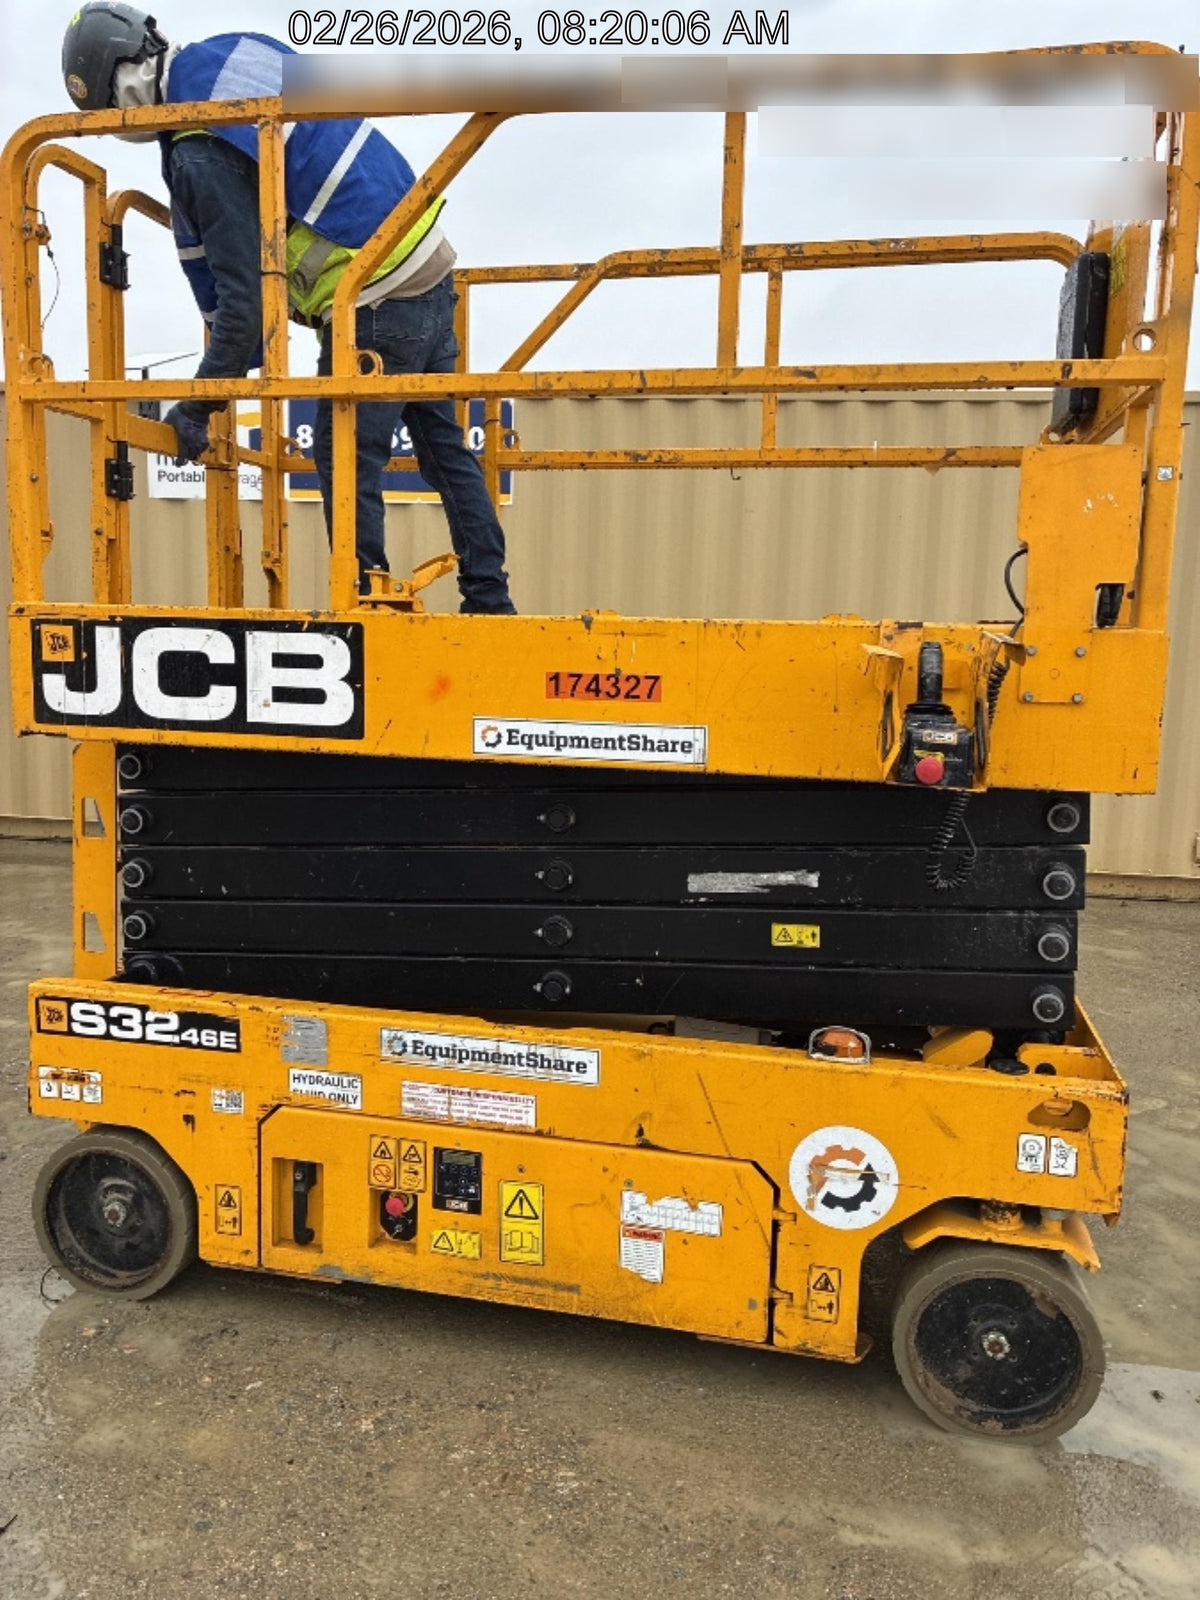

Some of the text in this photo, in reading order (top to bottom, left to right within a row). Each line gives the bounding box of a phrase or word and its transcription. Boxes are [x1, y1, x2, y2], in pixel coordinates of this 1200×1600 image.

[157, 470, 205, 482] Portabl
[42, 625, 354, 726] JCB
[549, 672, 661, 699] 174327
[506, 728, 692, 754] EquipmentShare
[411, 1040, 588, 1074] EquipmentShare
[292, 1073, 358, 1089] HYDRAULIC
[328, 1092, 358, 1104] ONLY
